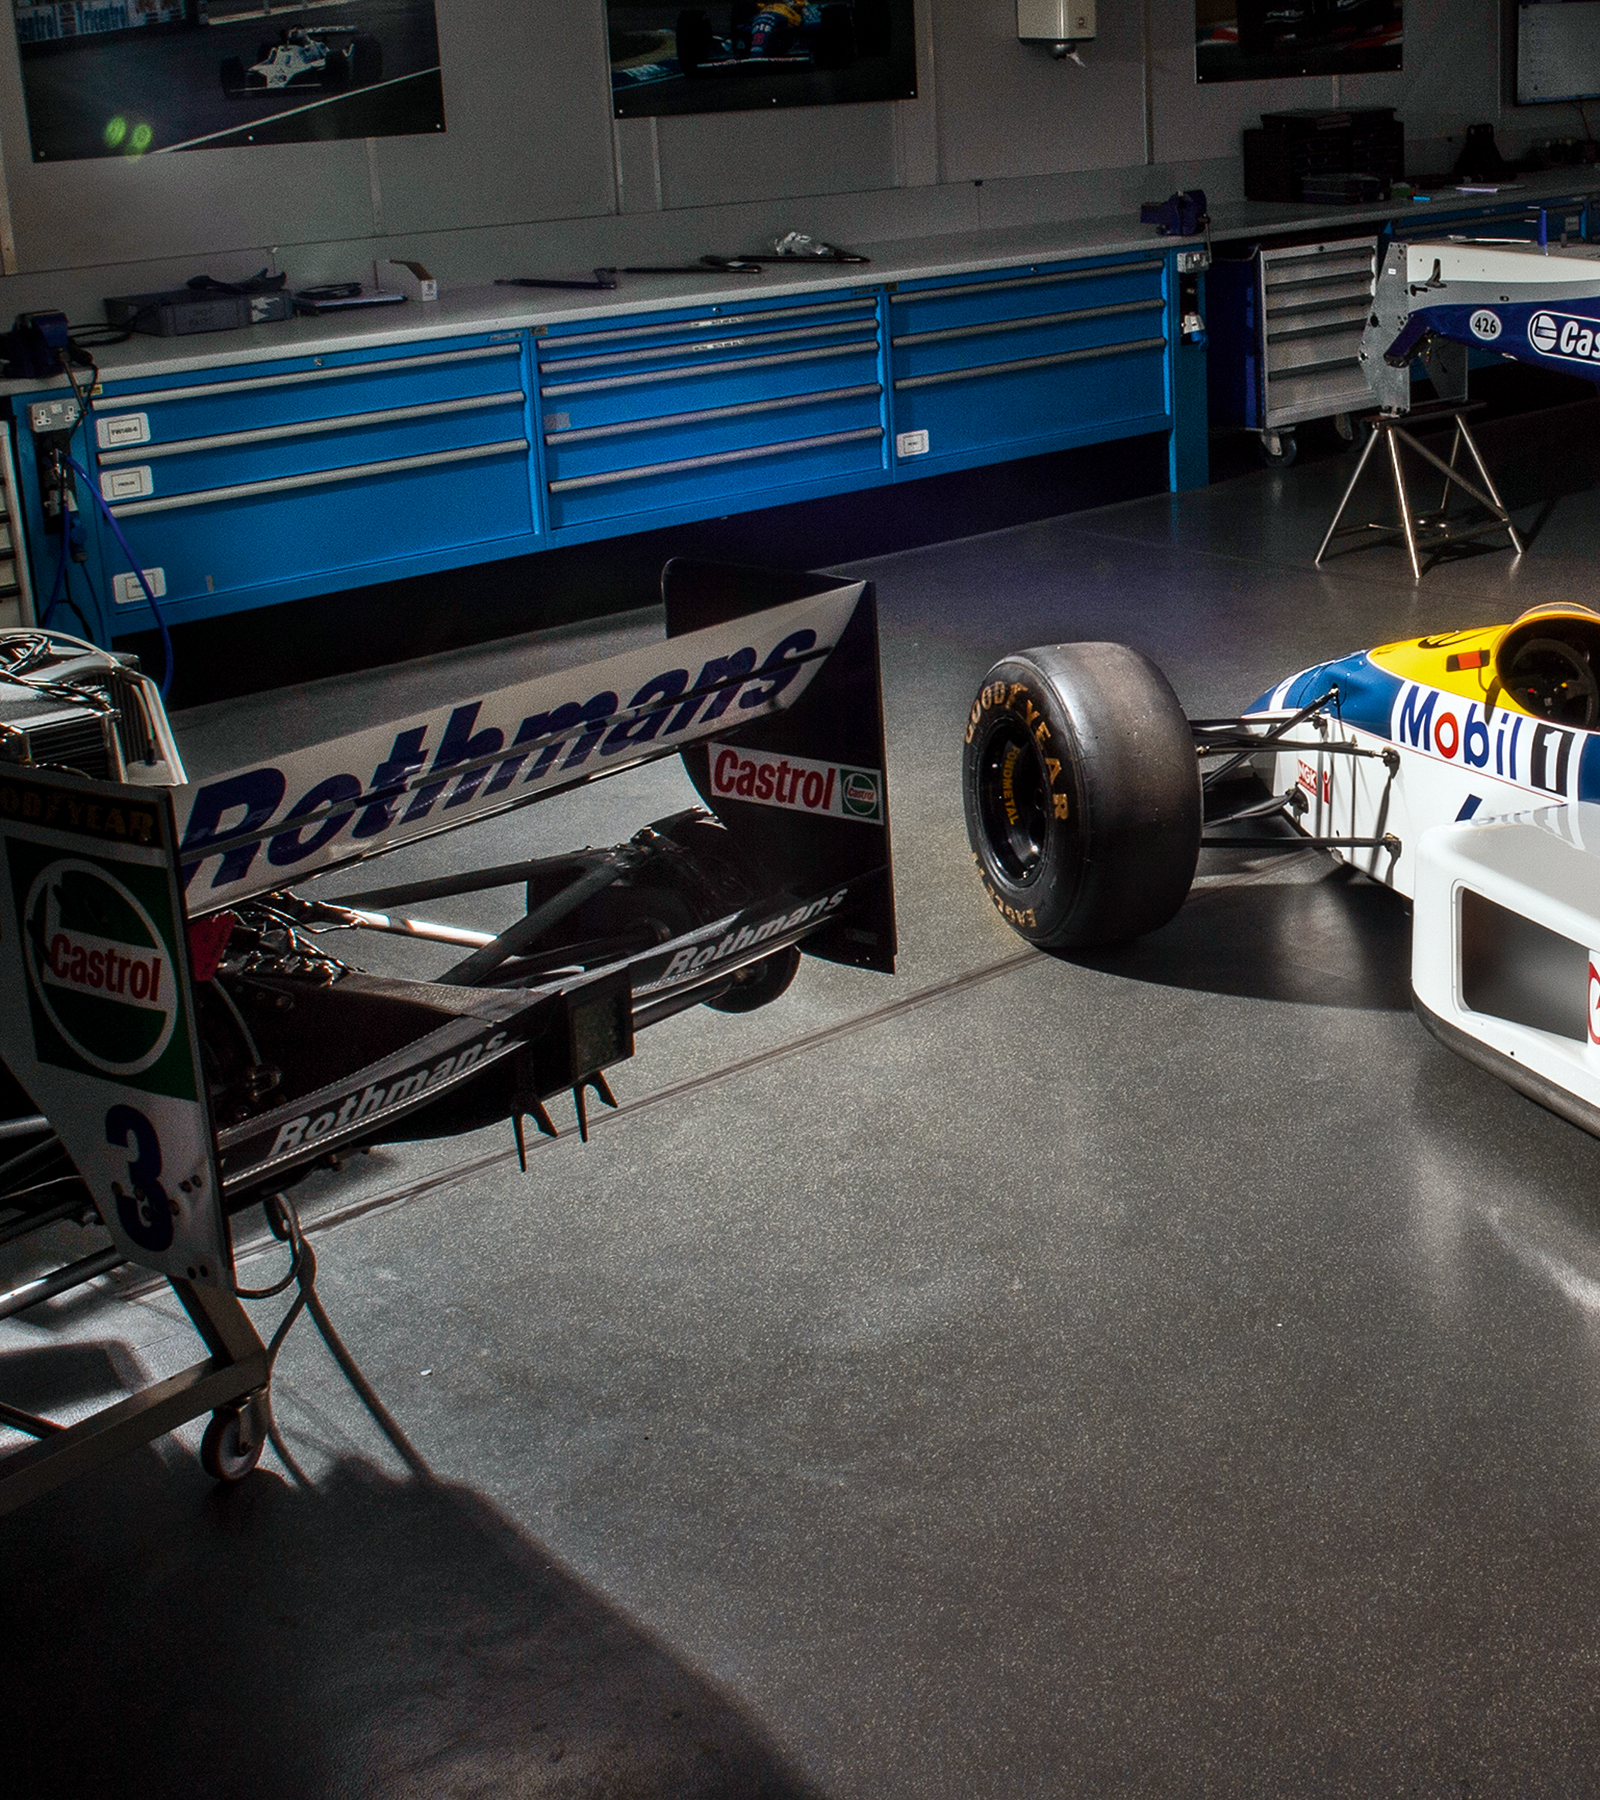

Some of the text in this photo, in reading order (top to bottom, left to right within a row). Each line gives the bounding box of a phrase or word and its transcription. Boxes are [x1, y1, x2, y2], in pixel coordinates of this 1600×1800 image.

[1474, 316, 1497, 334] 426
[181, 628, 817, 890] Rothmans
[1299, 762, 1317, 790] NGK
[1400, 684, 1564, 792] Mobil 1
[714, 749, 836, 810] Castrol
[847, 787, 875, 801] Castrol
[1002, 746, 1020, 825] FONDMETAL
[50, 934, 162, 1003] Castrol
[661, 885, 848, 979] Rothmans
[268, 1030, 508, 1157] Rothmans
[105, 1104, 174, 1252] 3
